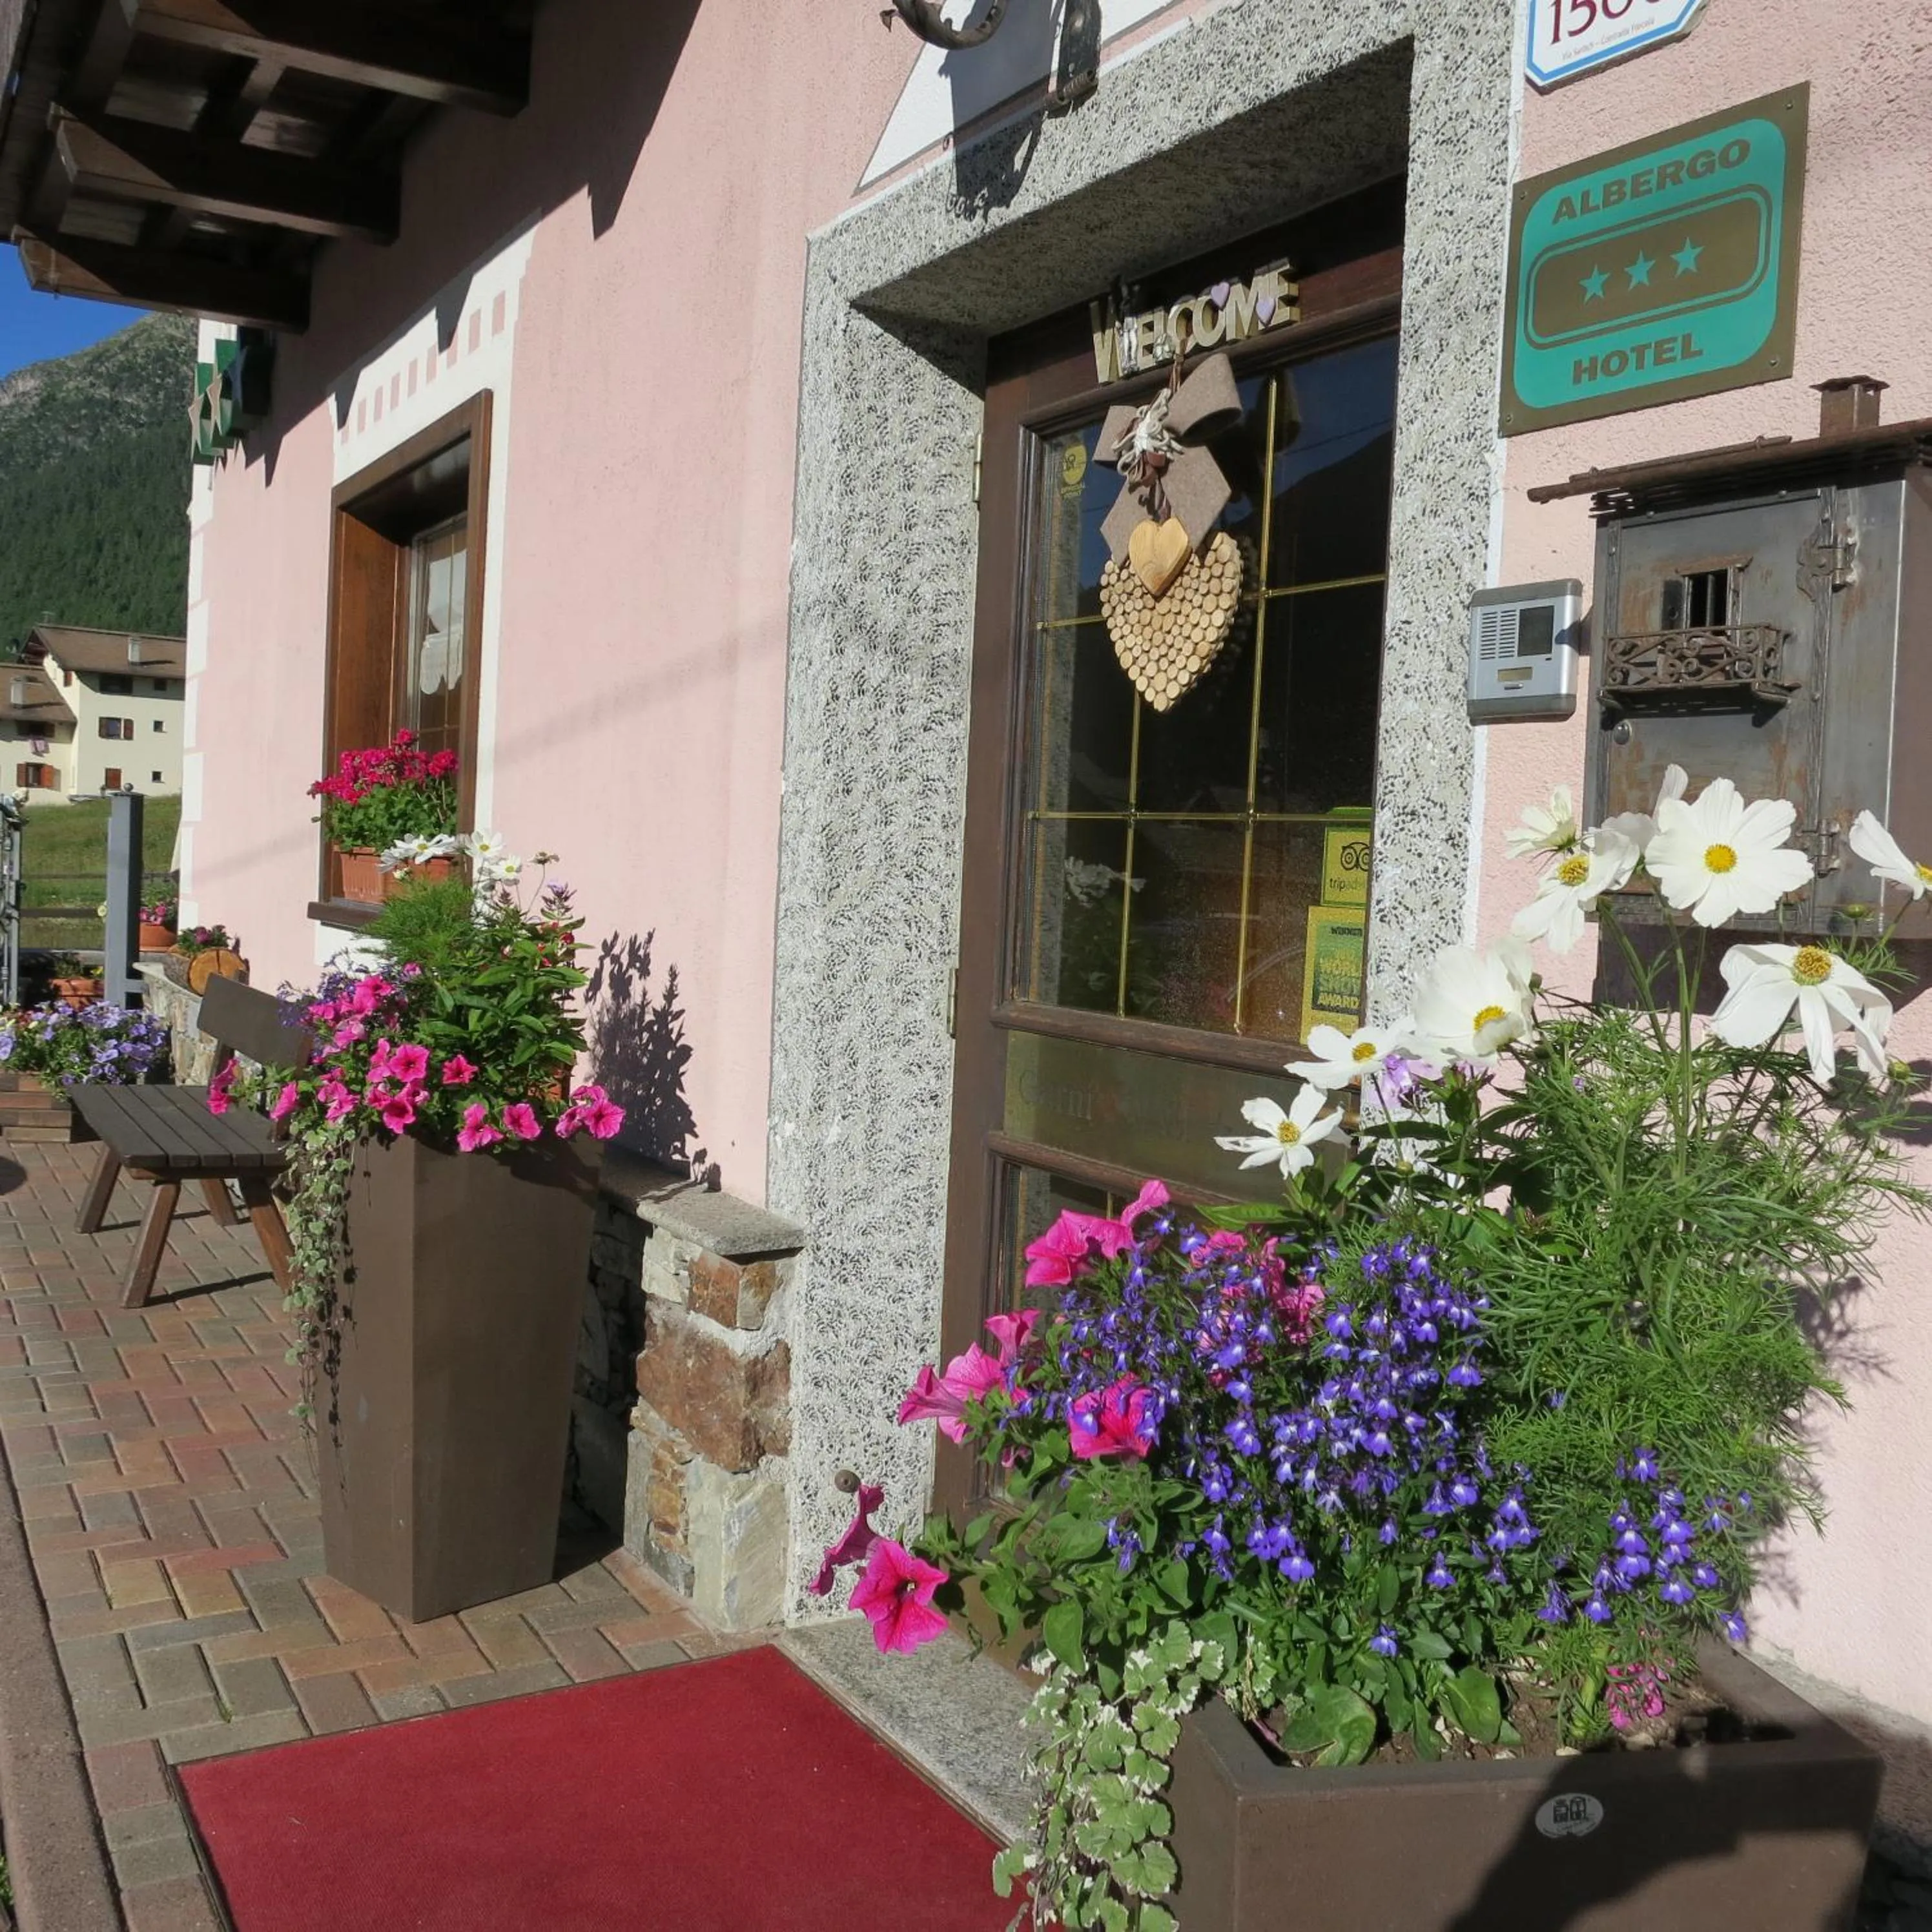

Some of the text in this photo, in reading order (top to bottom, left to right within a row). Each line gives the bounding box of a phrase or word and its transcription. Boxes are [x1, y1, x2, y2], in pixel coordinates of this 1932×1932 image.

[1552, 138, 1751, 225] ALBERGO
[1572, 332, 1703, 385] HOTEL
[1318, 992, 1360, 1009] AWARD
